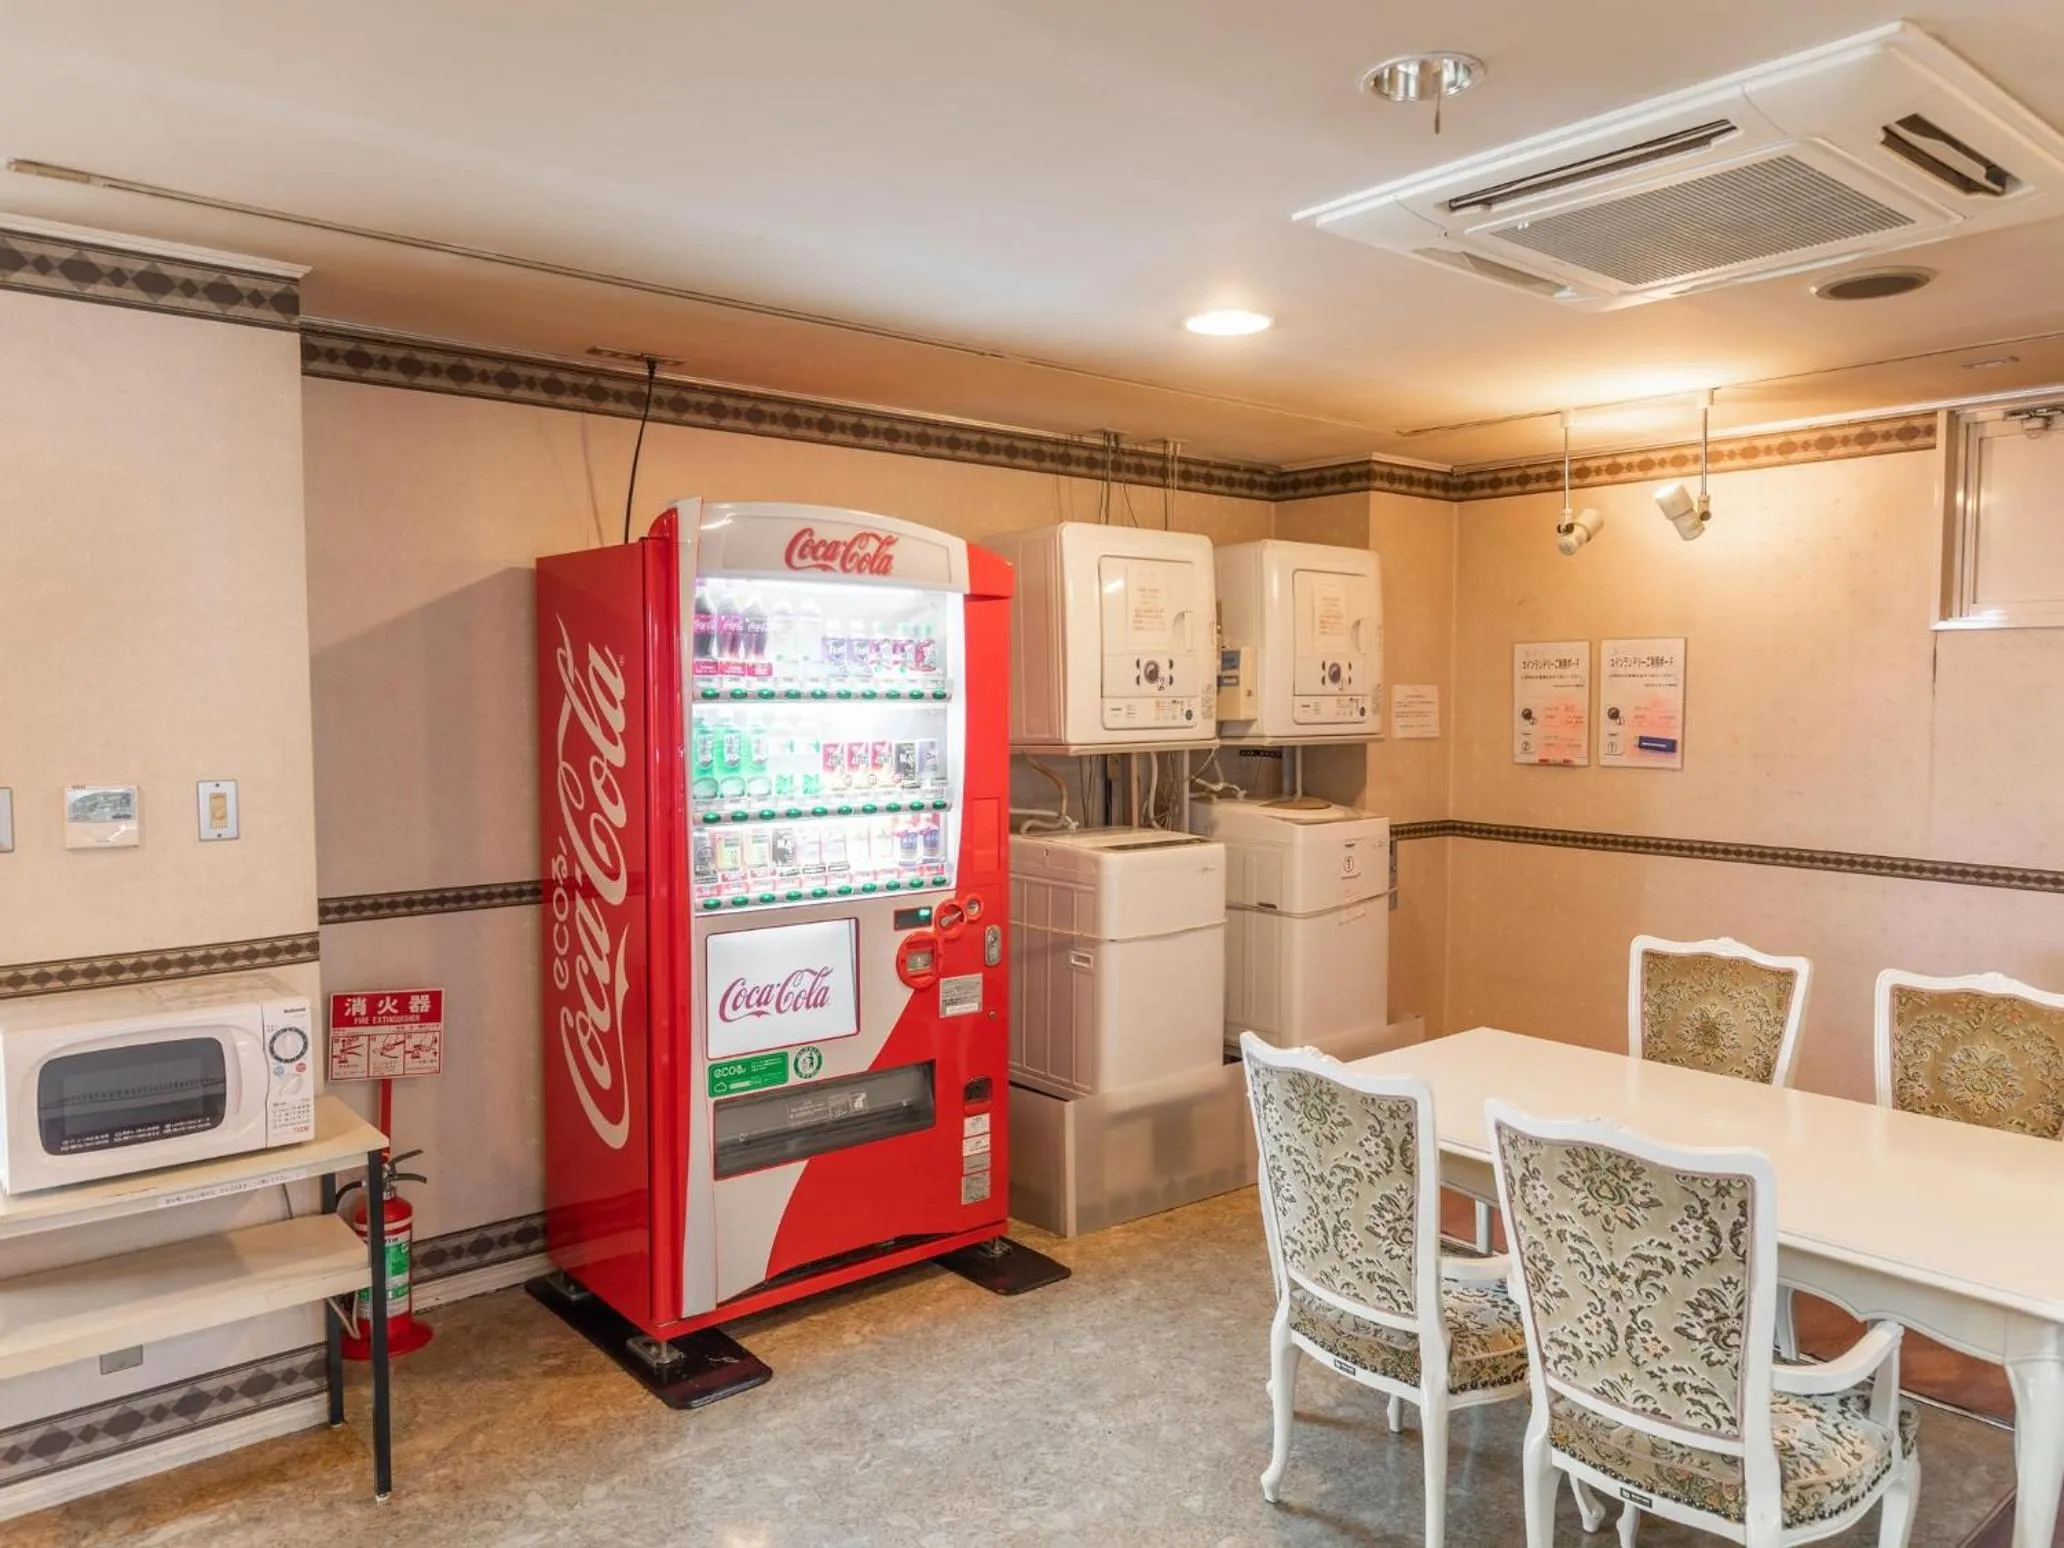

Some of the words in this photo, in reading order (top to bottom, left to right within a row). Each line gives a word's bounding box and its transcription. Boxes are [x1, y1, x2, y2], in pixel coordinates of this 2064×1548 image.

[785, 527, 899, 575] Coca-Cola
[556, 612, 629, 1150] Coca-Cola
[344, 994, 432, 1017] 消火器
[718, 966, 834, 1023] Coca-Cola
